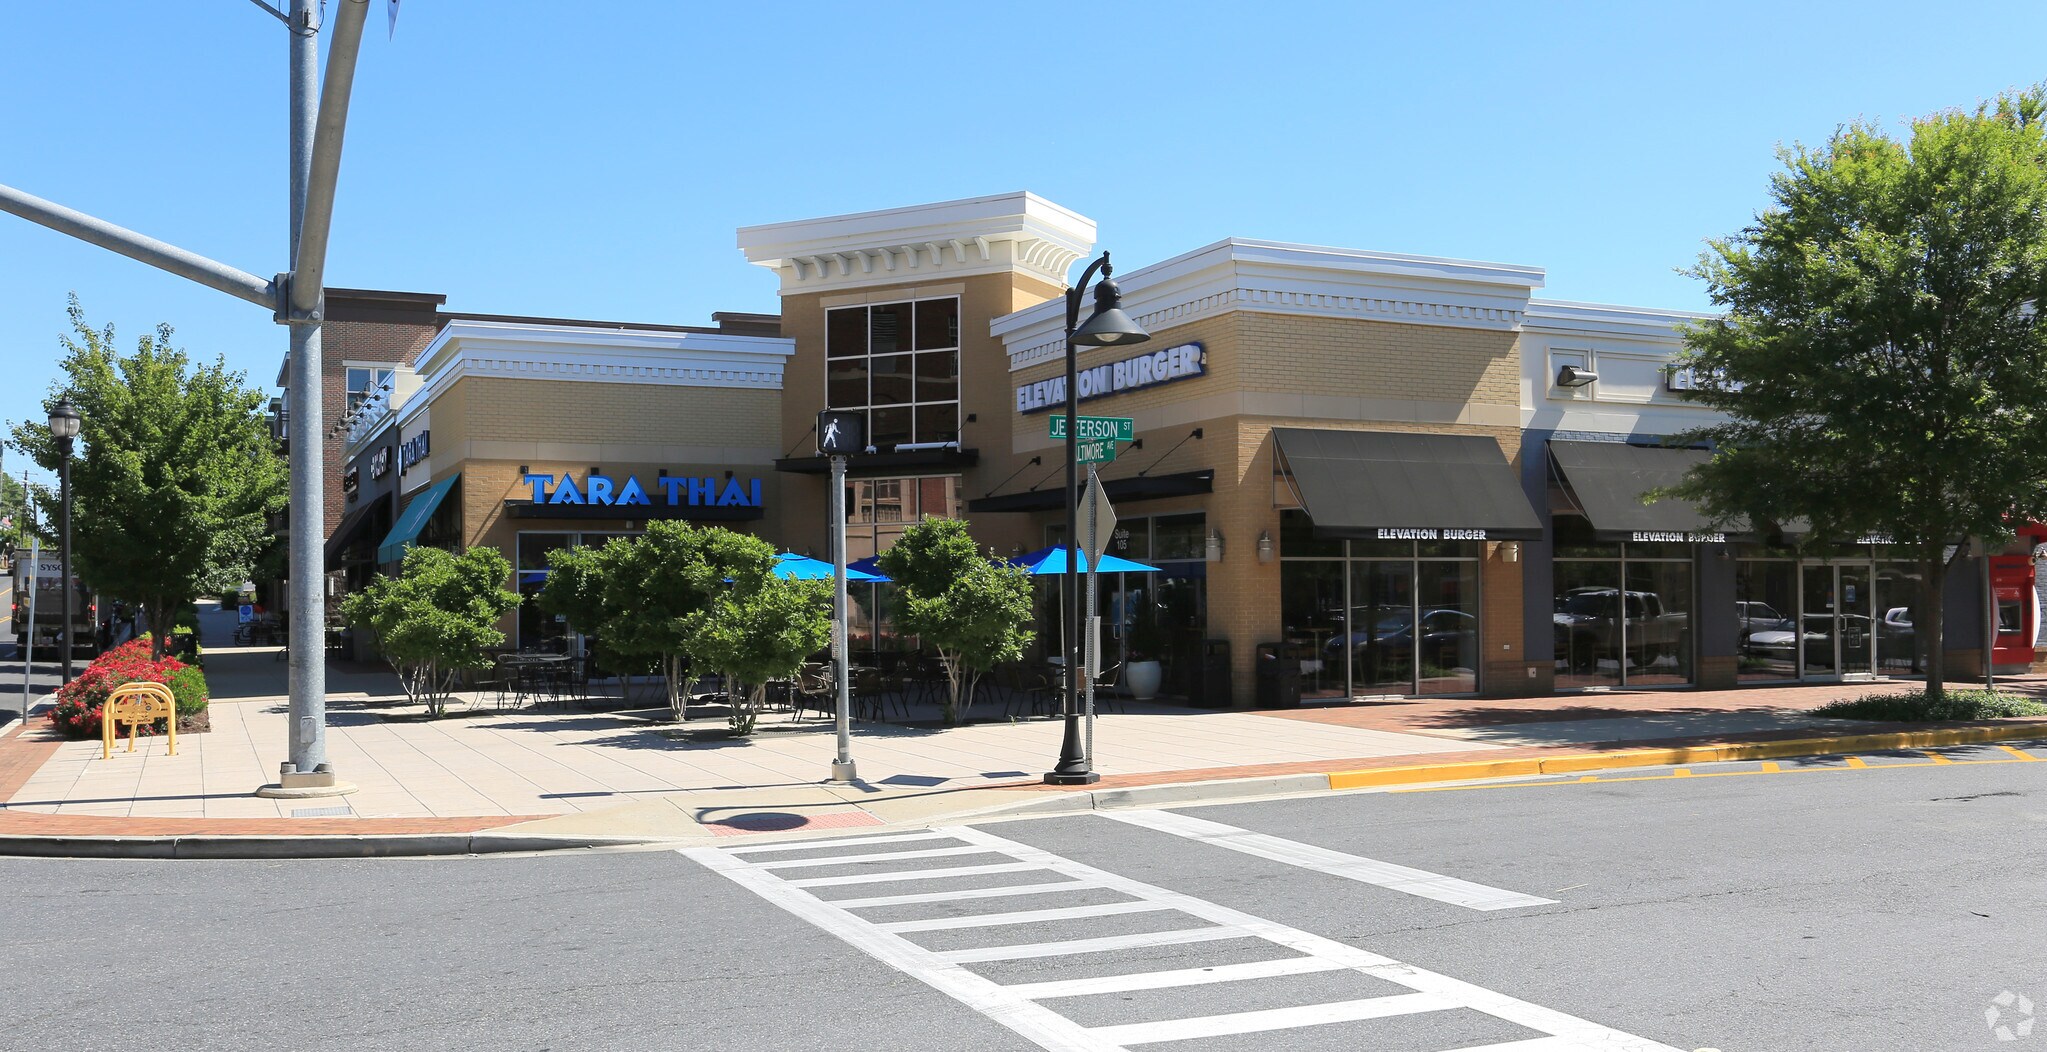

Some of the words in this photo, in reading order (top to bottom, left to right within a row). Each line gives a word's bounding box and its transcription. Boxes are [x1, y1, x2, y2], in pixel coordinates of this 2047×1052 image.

[1113, 344, 1201, 391] BURGER
[1051, 419, 1118, 437] JEERSON
[1123, 422, 1131, 431] ST
[1106, 440, 1114, 450] AVE
[524, 472, 651, 506] TARA
[658, 475, 762, 507] THAI
[1114, 529, 1130, 539] Suite
[1377, 528, 1438, 540] ELEVATION
[1443, 529, 1487, 540] BURGER
[1632, 531, 1684, 542] ELEVATION
[1116, 540, 1127, 550] 105
